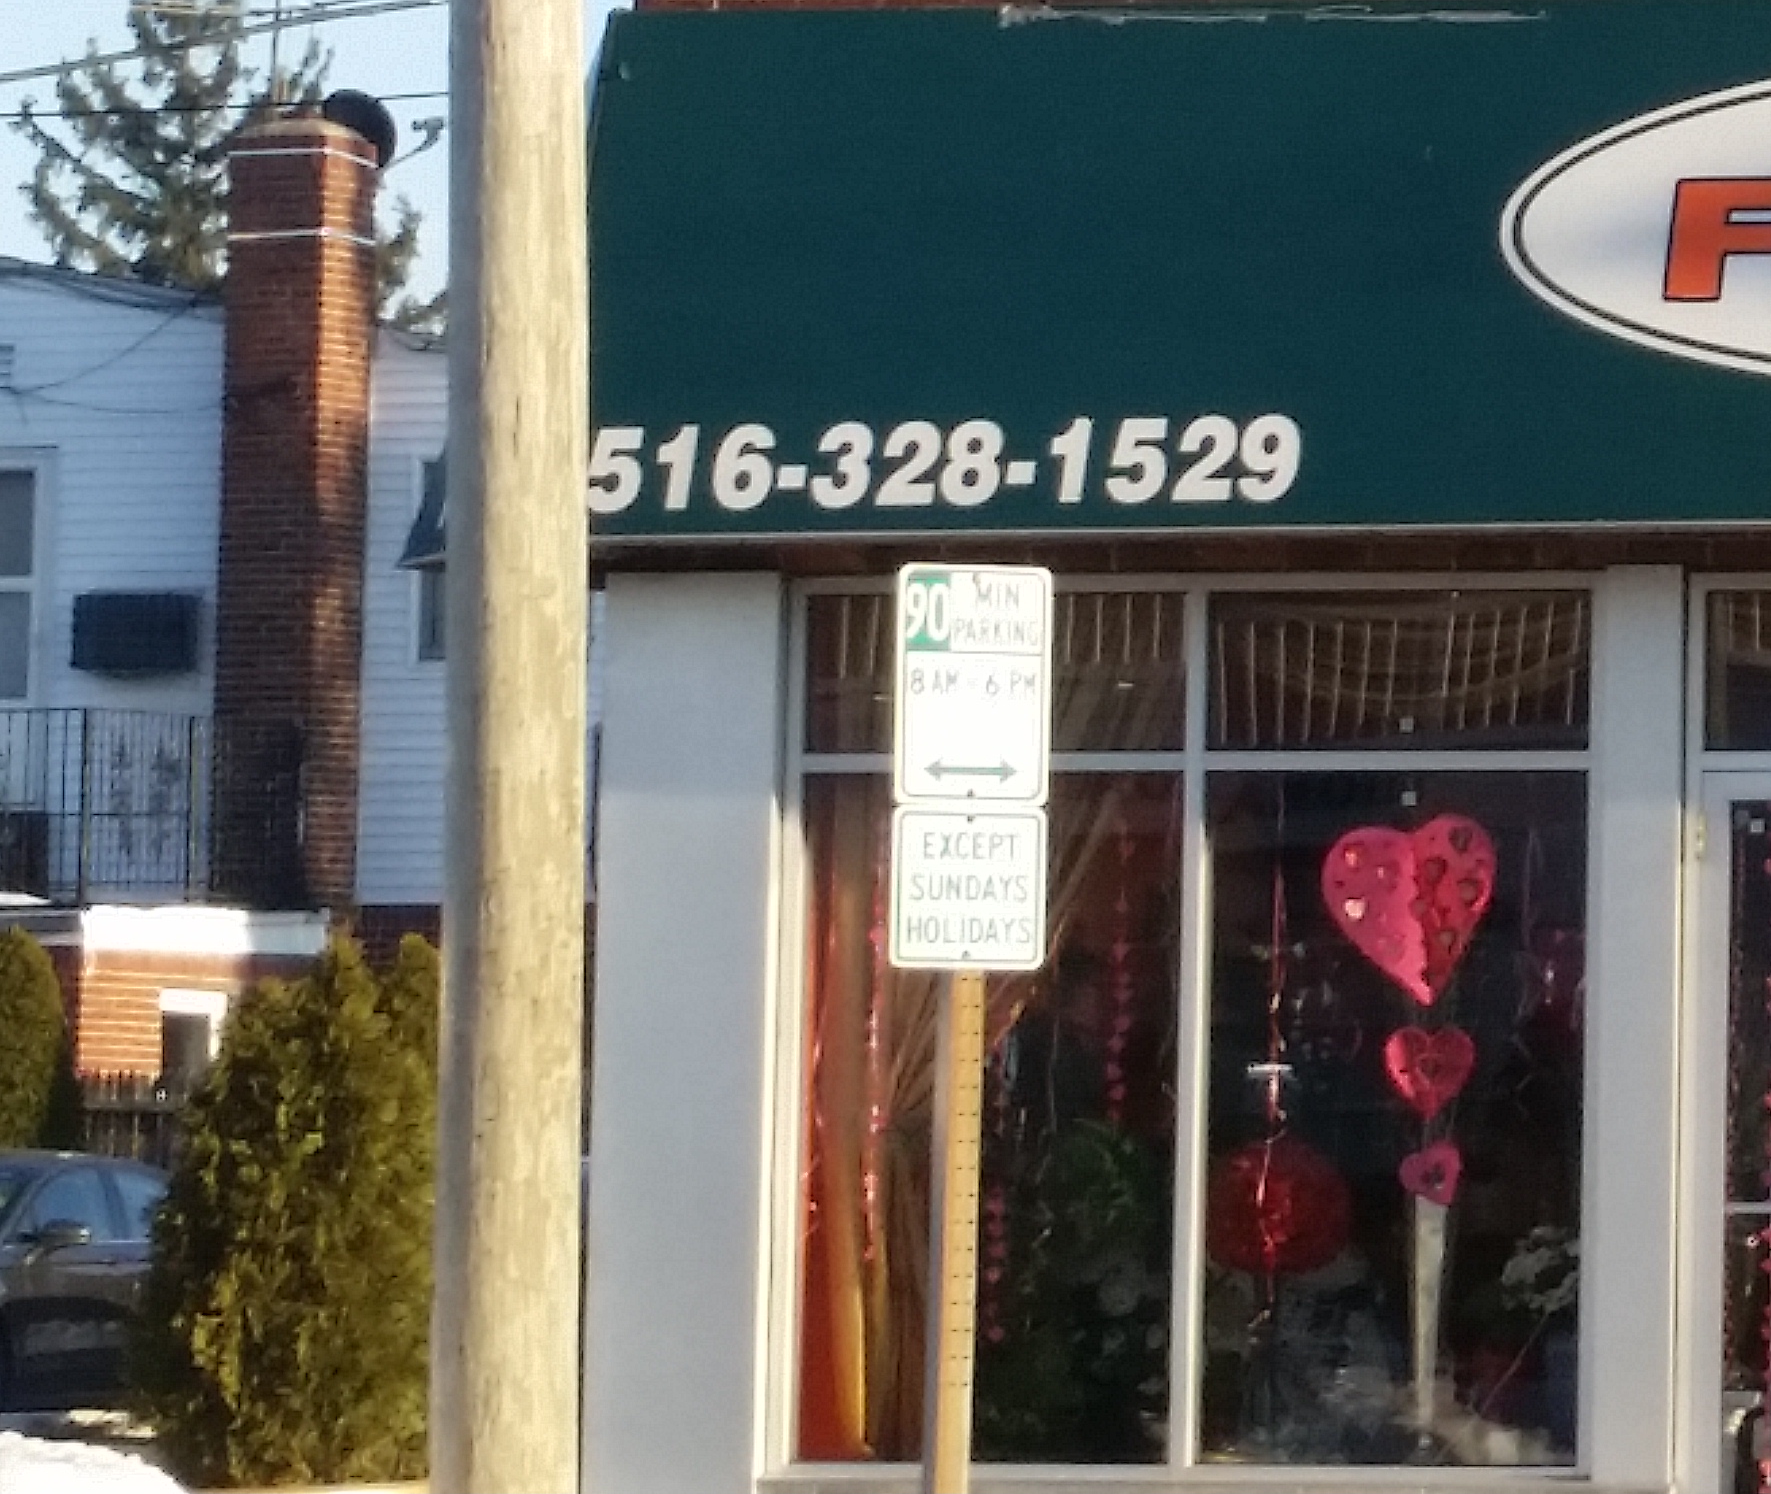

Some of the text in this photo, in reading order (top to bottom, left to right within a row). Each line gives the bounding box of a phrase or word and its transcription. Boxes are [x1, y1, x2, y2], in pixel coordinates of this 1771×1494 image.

[589, 413, 1302, 514] 516-328-1529
[975, 581, 1020, 609] MIN
[906, 583, 951, 642] 90
[953, 618, 1039, 647] PARKING
[910, 667, 925, 695] 8
[932, 669, 960, 695] AM
[985, 674, 1000, 698] 6
[1009, 669, 1037, 696] PM
[923, 831, 1020, 861] EXCEPT
[909, 873, 1030, 902] SUNDAYS
[907, 916, 1031, 945] HOLIDAYS
